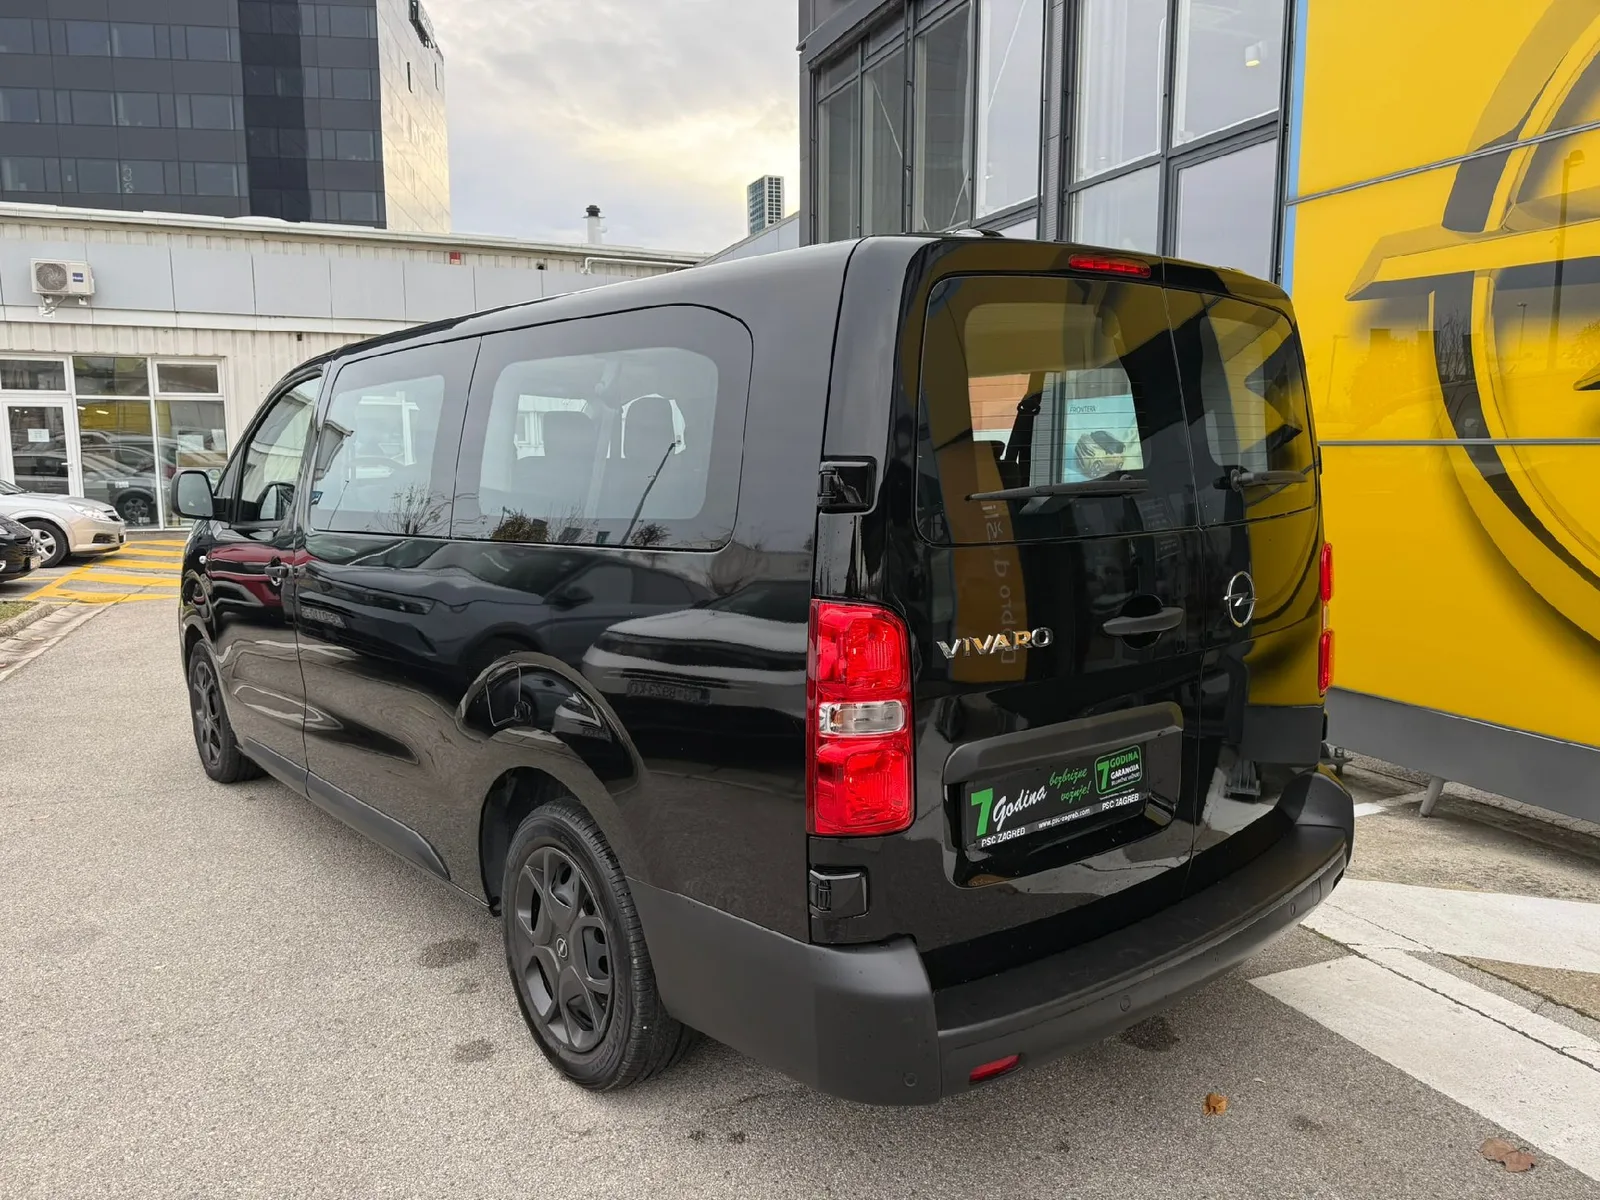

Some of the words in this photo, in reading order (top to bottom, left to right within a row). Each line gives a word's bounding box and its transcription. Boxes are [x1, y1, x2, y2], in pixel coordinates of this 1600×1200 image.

[1069, 405, 1097, 413] FRONTERA
[936, 627, 1053, 659] VIVARO
[1097, 761, 1110, 790] 7
[1109, 751, 1139, 768] GODINA
[971, 788, 993, 836] 7
[993, 785, 1047, 831] Godina
[1102, 800, 1115, 811] PSC
[1115, 793, 1140, 808] ZAGREB
[1038, 807, 1091, 829] www.psc-zagreb.com
[981, 835, 996, 847] PSC
